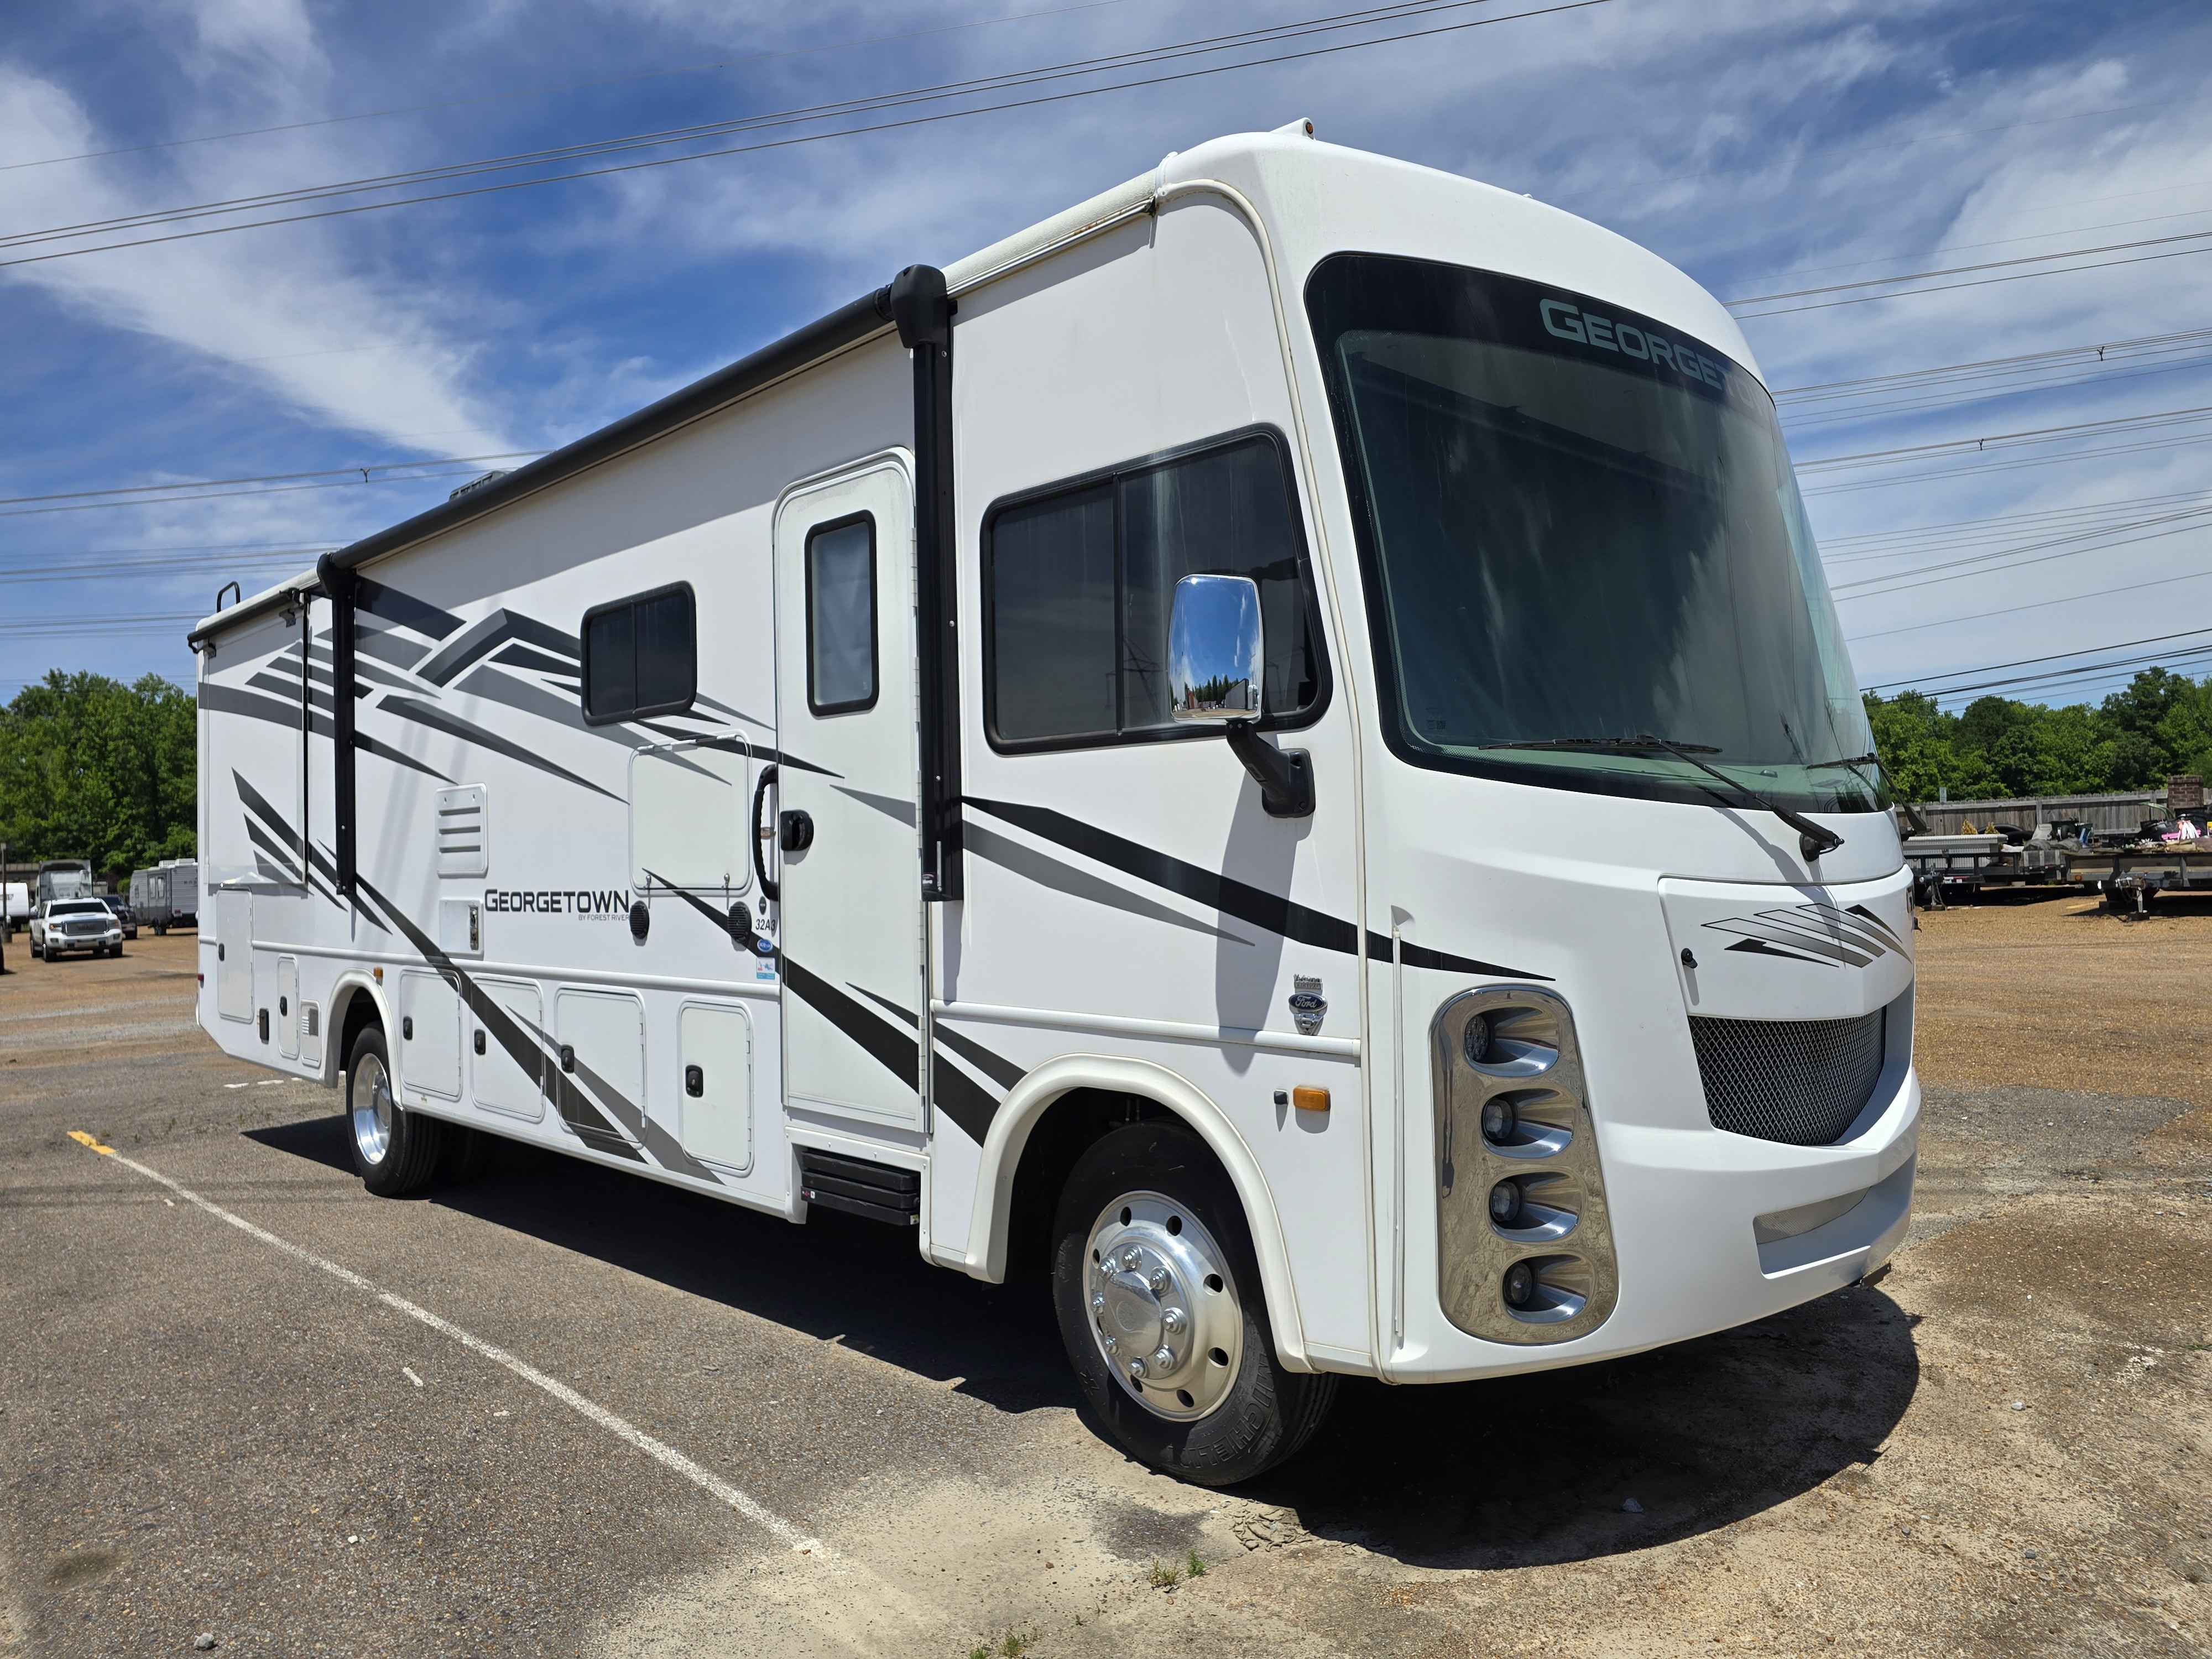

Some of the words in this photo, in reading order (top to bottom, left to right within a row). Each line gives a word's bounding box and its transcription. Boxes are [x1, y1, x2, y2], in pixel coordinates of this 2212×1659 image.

[484, 888, 629, 913] GEORGETOWN
[755, 918, 776, 931] 32A3
[1295, 995, 1317, 1008] Ford
